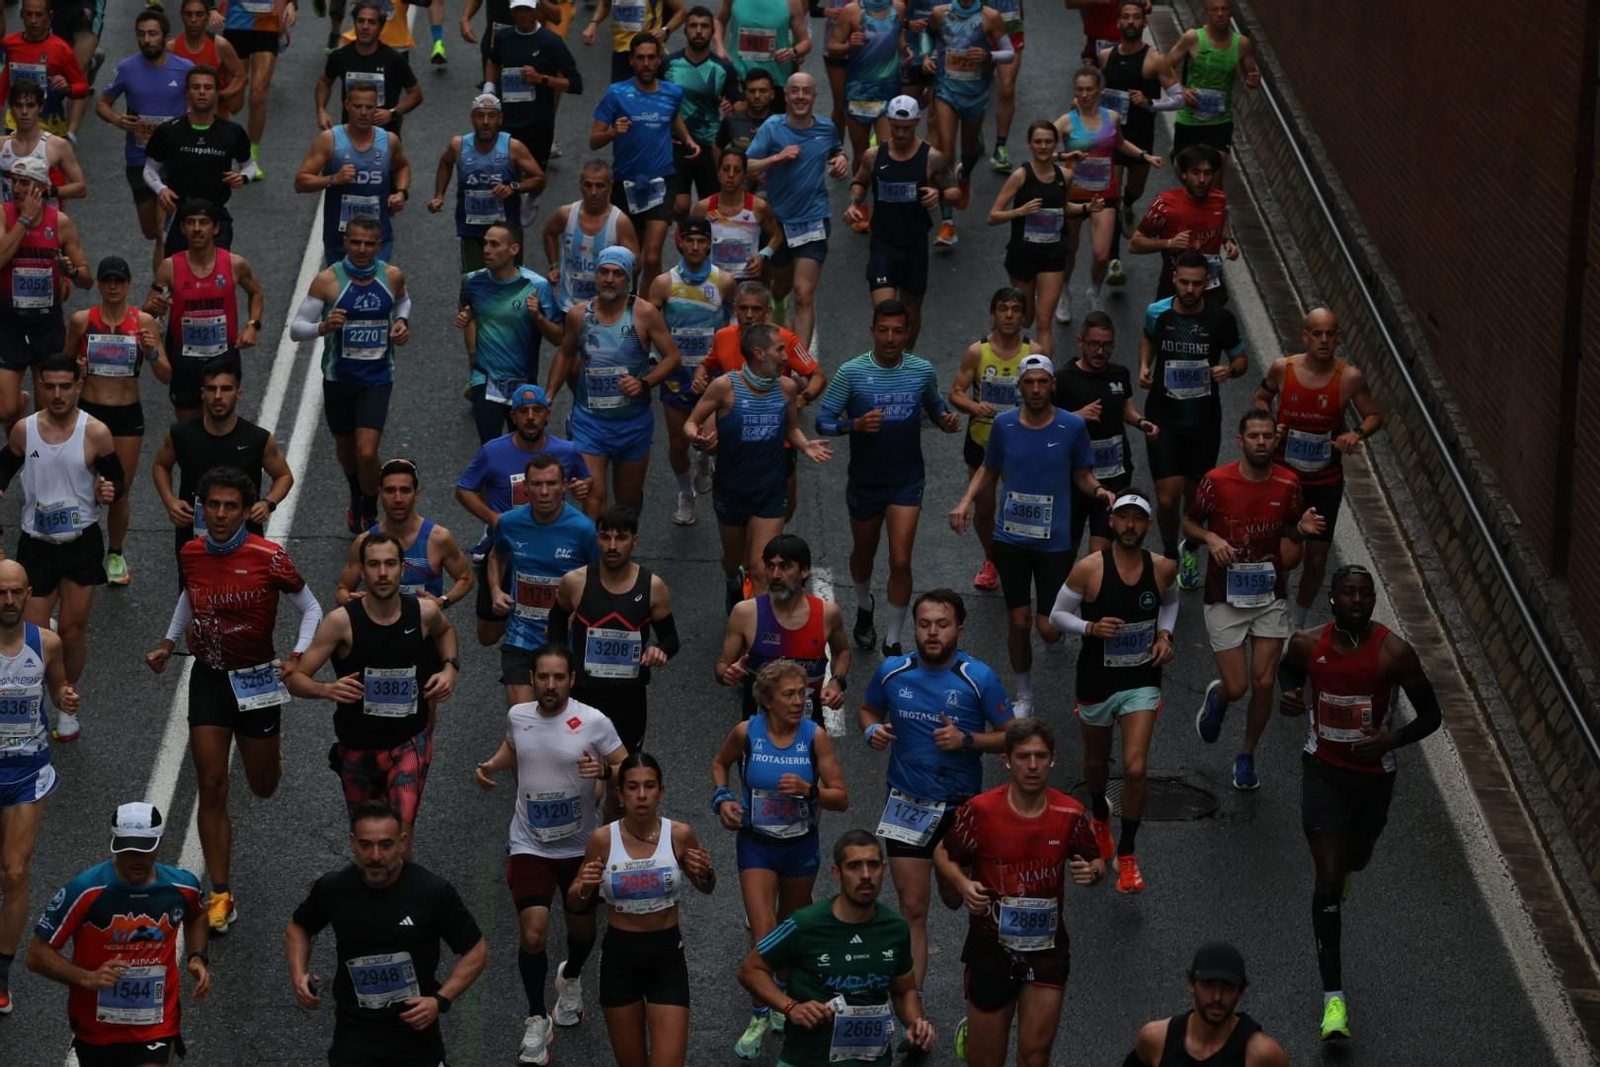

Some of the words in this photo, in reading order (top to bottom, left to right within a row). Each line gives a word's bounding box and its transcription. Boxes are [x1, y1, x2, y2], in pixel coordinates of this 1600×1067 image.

[19, 278, 48, 291] 2052
[188, 324, 216, 340] 2121
[349, 329, 379, 343] 2270
[1161, 339, 1174, 352] AD
[1174, 340, 1210, 355] CERNE
[986, 386, 1015, 400] 2979
[1011, 502, 1042, 519] 3366
[38, 512, 69, 528] 2156
[1234, 574, 1266, 588] 3159
[594, 641, 629, 657] 3208
[1114, 634, 1145, 649] 3407
[240, 670, 274, 689] 3255
[373, 681, 409, 696] 3382
[751, 753, 811, 767] TROTASIERRA
[534, 803, 569, 822] 3120
[893, 802, 930, 823] 1727
[619, 872, 661, 894] 2985
[1009, 910, 1048, 929] 2889
[359, 968, 400, 987] 2948
[111, 980, 152, 1000] 1544
[843, 1019, 884, 1039] 2669
